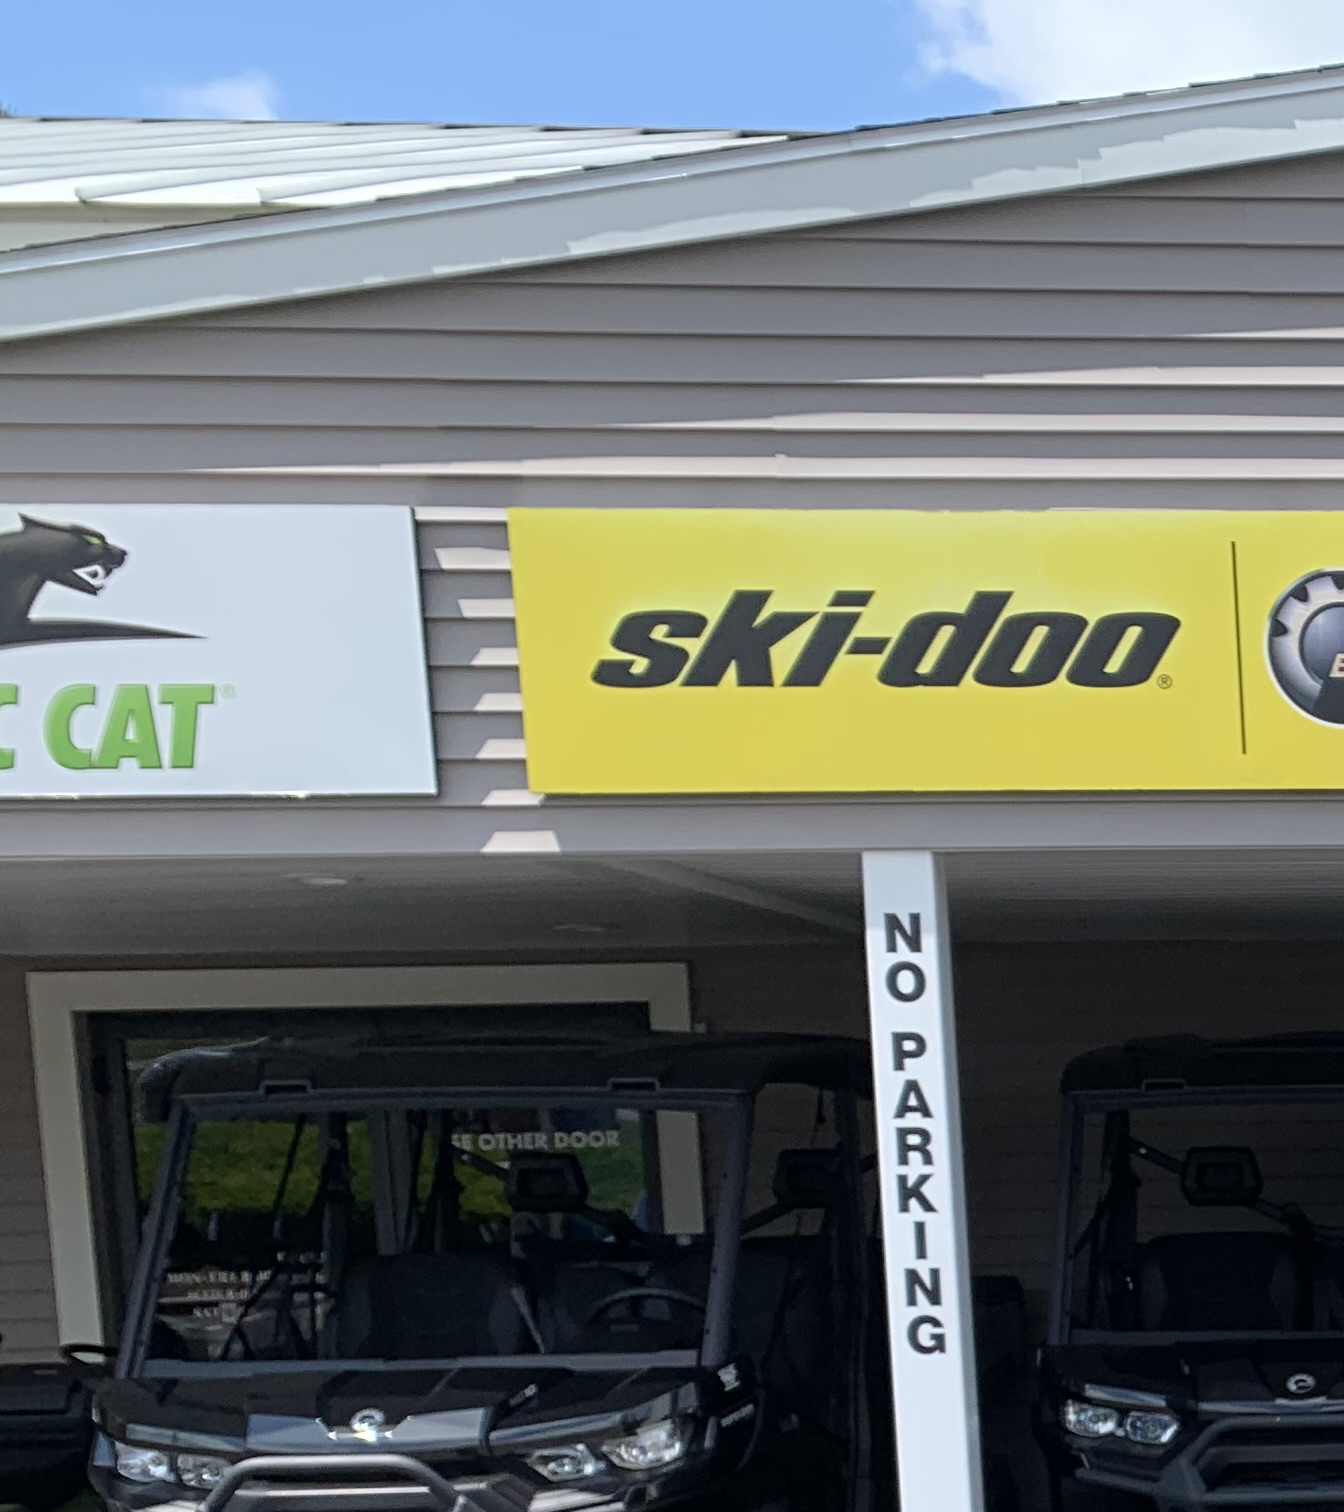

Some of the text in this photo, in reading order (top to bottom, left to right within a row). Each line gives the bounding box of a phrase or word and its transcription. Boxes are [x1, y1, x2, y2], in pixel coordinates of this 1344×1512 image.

[590, 590, 1181, 688] ski-doo
[43, 683, 214, 770] CAT
[477, 1131, 548, 1151] OTHER
[554, 1129, 620, 1149] DOOR
[883, 912, 947, 1355] NO PARKING
